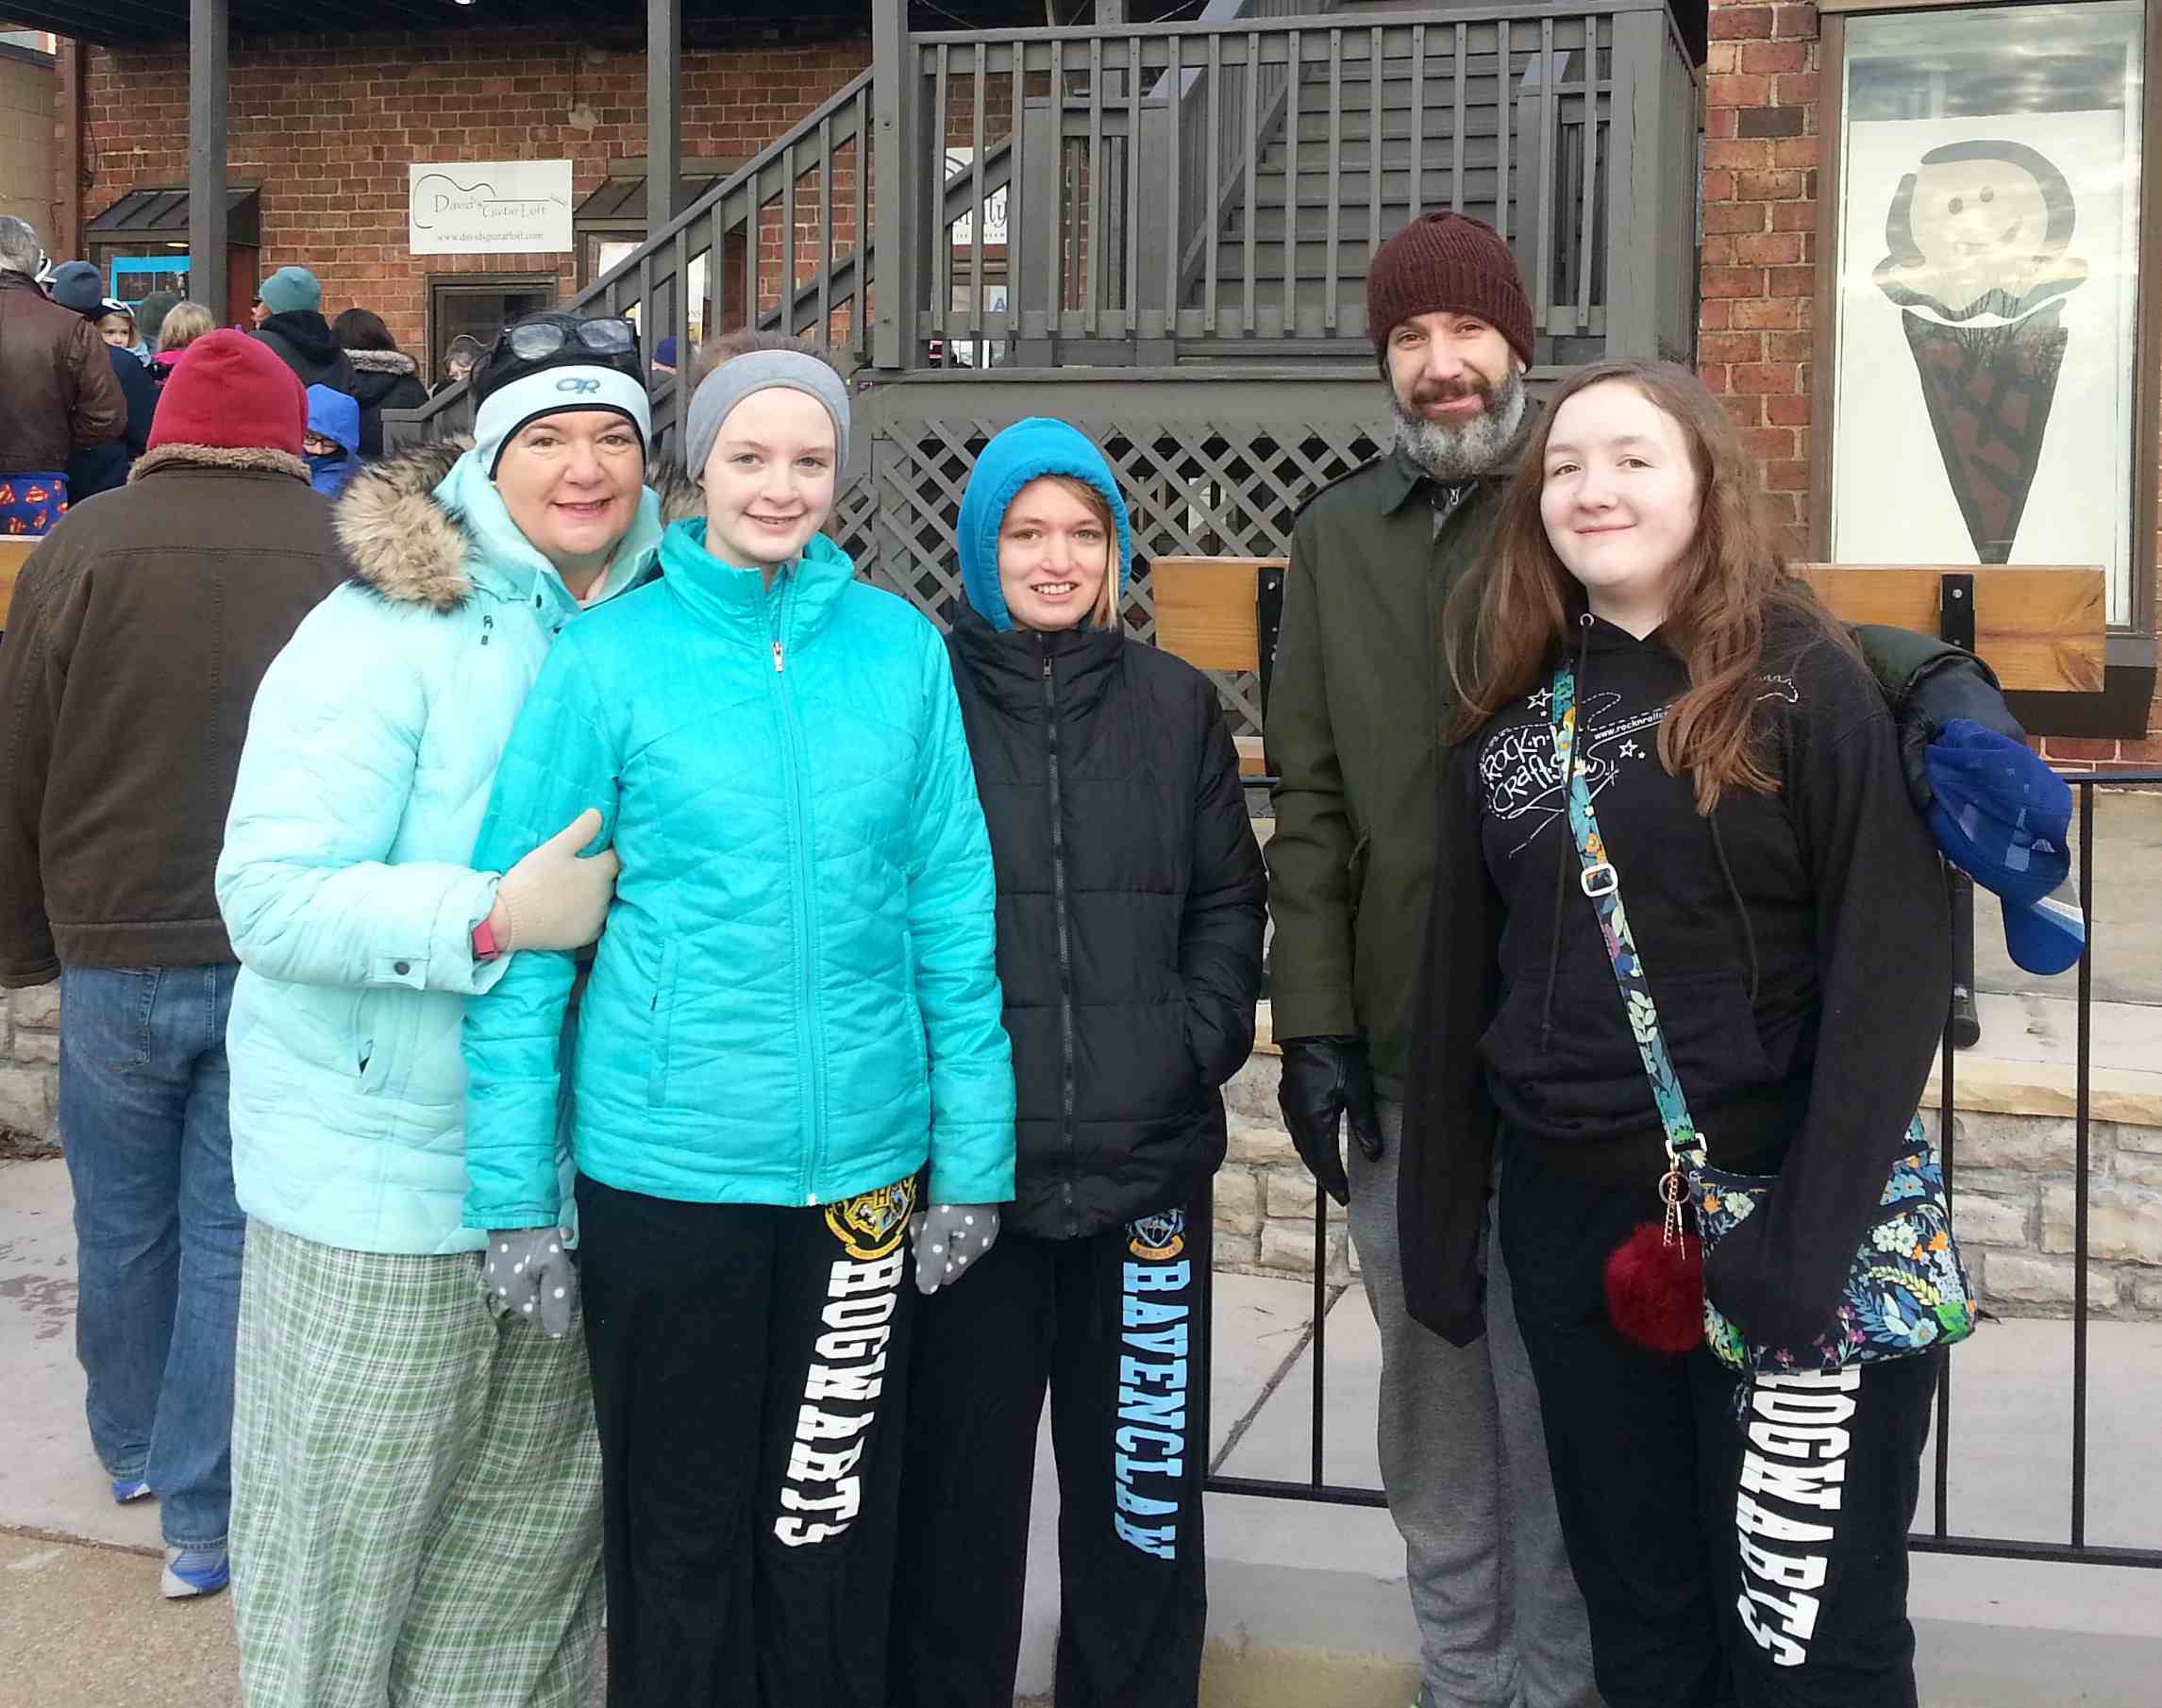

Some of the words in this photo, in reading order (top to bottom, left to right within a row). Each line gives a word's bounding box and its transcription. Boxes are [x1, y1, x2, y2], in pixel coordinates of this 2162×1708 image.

[434, 193, 483, 213] David's
[521, 202, 546, 218] Loft
[774, 1247, 904, 1547] HOGWARTS
[1115, 1260, 1191, 1559] RAVENCLAW
